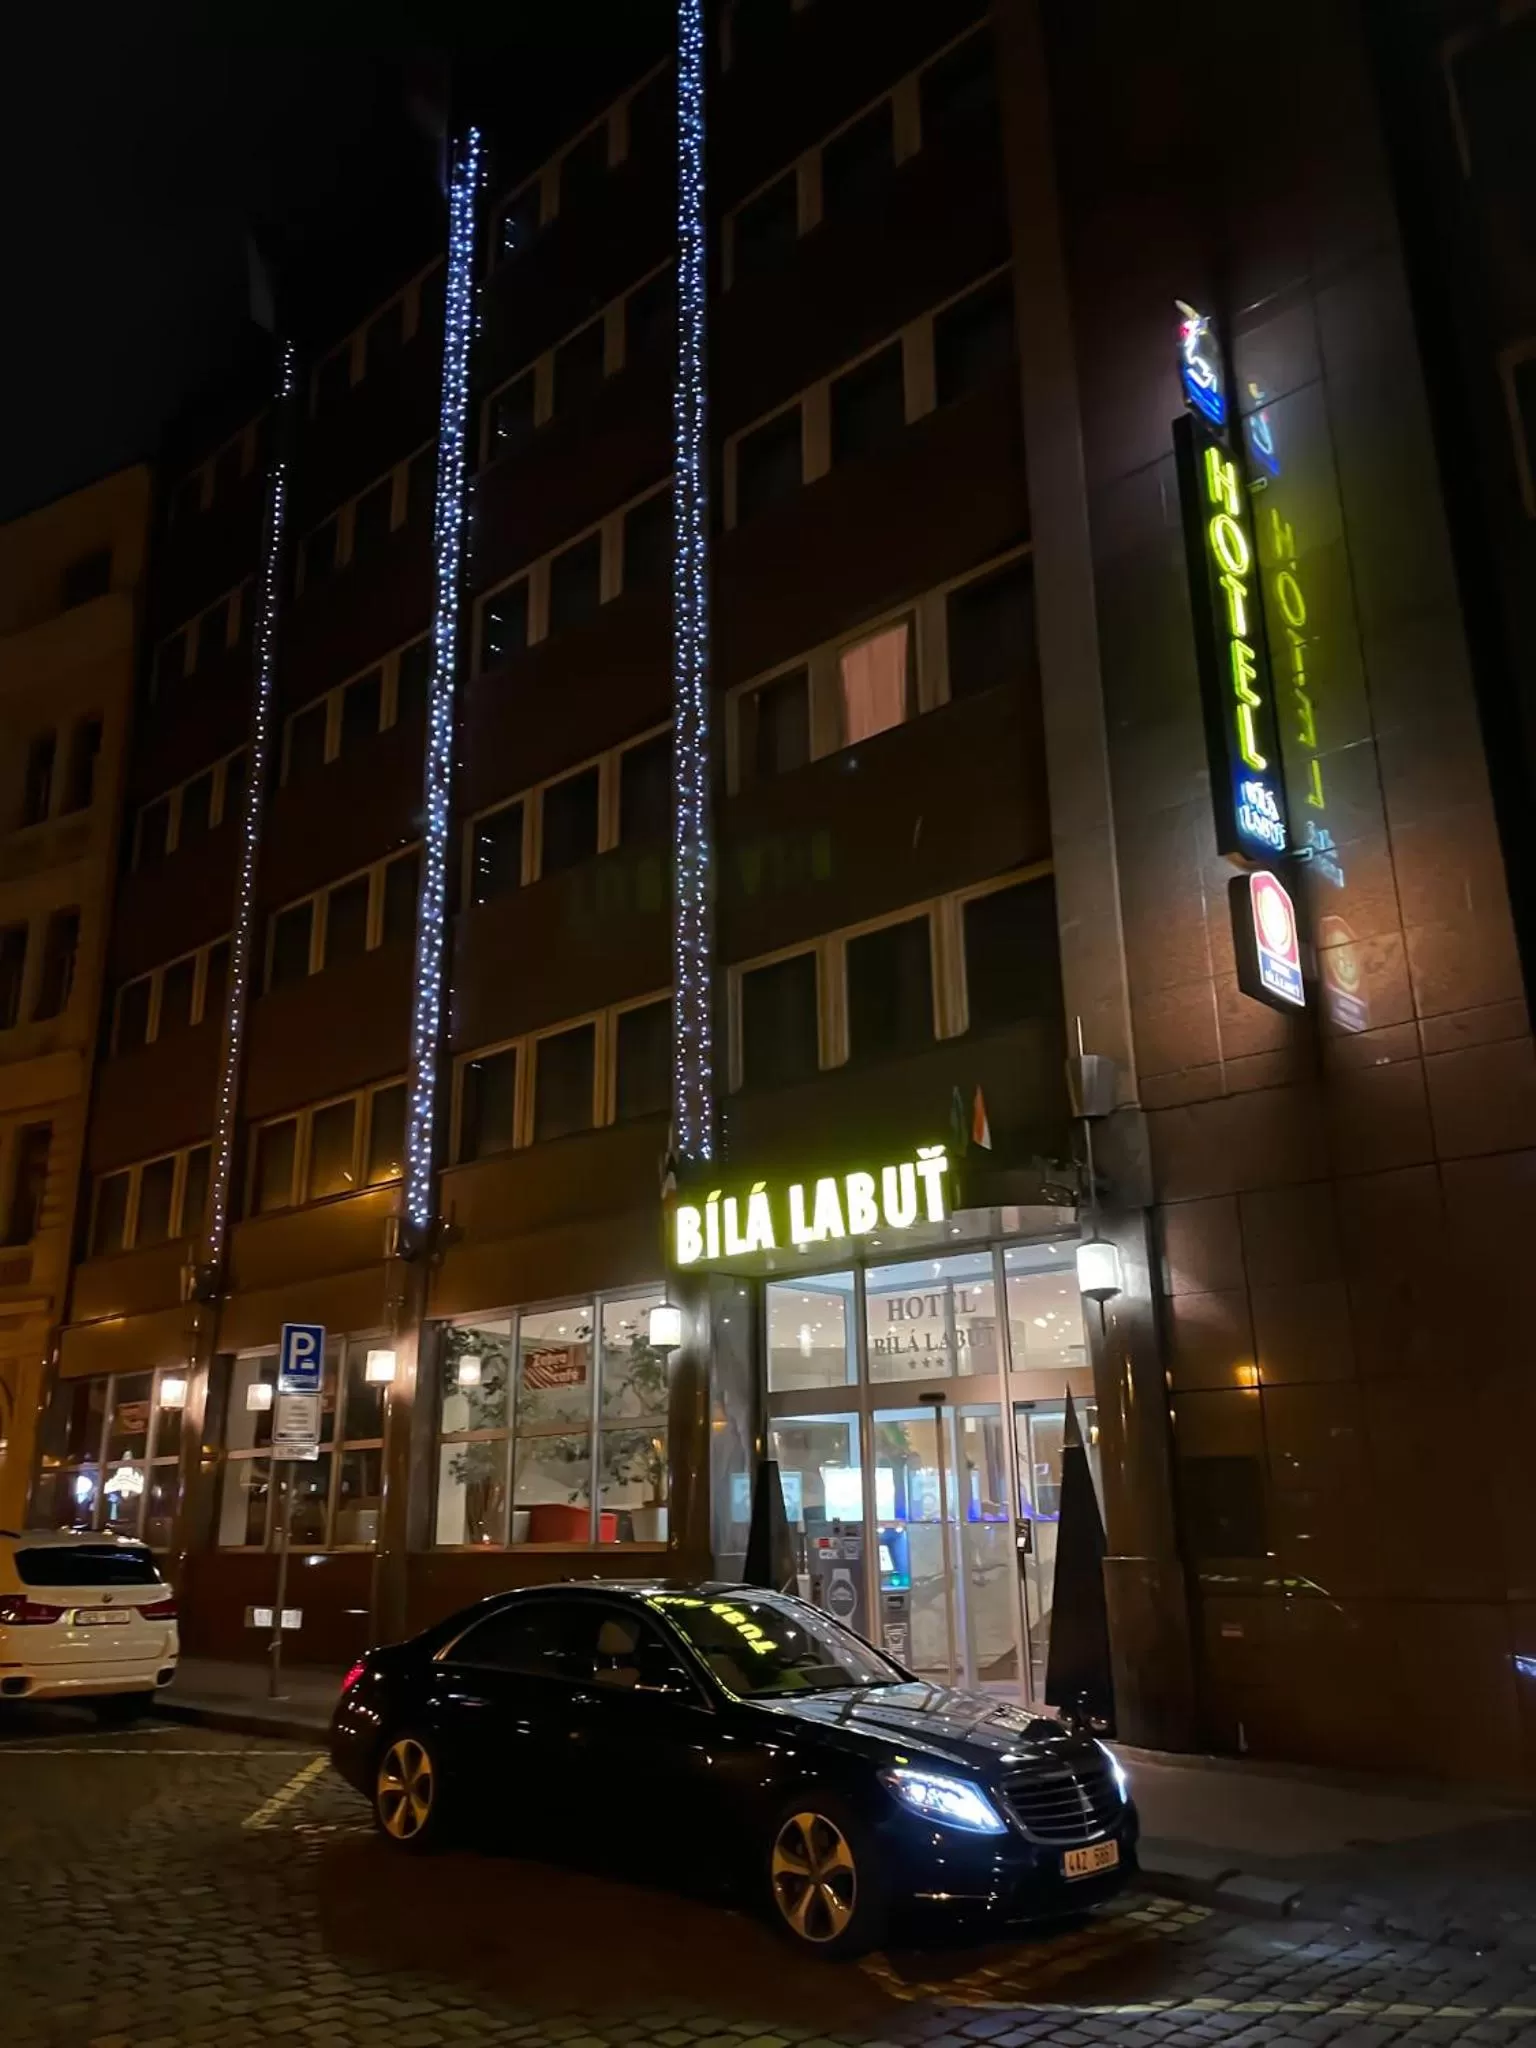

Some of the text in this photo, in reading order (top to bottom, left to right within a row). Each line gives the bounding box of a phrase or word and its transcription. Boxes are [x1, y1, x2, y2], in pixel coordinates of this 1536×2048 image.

[1205, 447, 1267, 770] HOTEL
[676, 1145, 949, 1265] BÍLÁ LABUŤ
[886, 1289, 977, 1321] HOTEL
[288, 1331, 316, 1370] P
